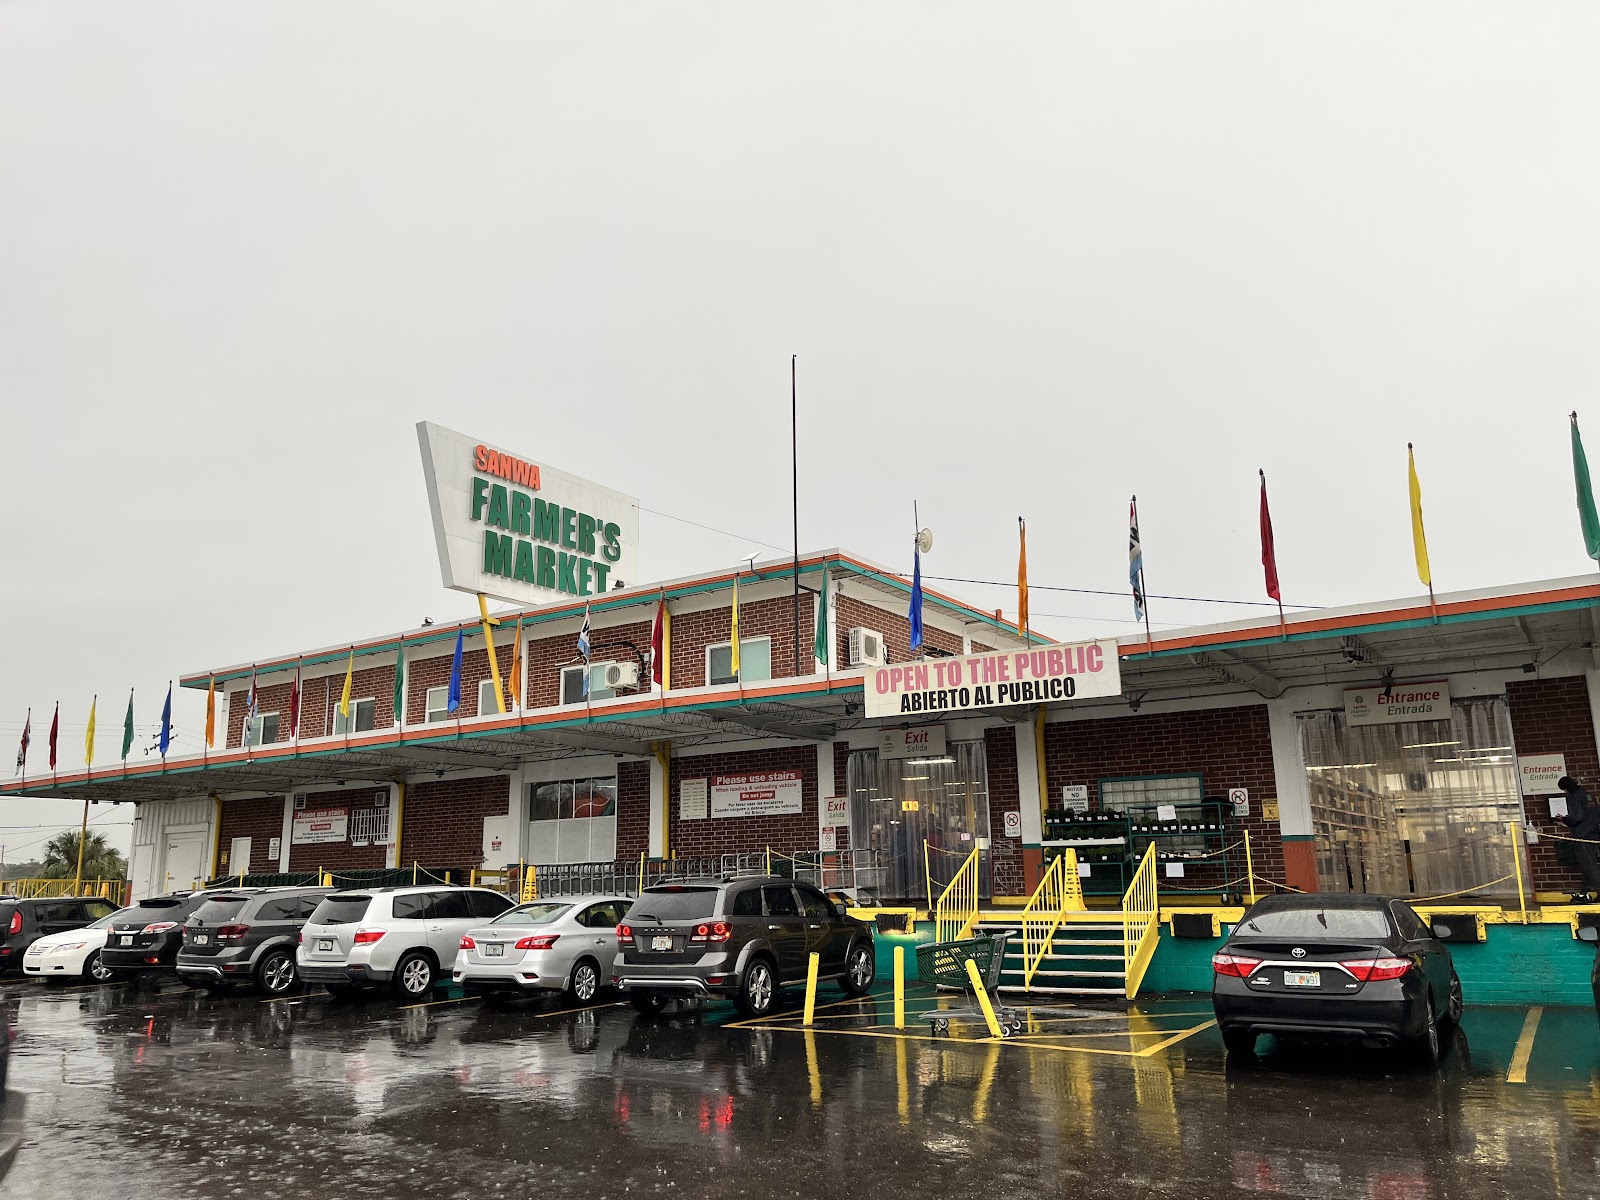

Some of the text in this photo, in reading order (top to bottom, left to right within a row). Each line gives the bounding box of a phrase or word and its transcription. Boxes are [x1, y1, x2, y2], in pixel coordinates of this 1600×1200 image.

[474, 444, 541, 491] SANWA
[469, 476, 621, 563] FARMER'S
[481, 530, 611, 597] MARKET
[875, 644, 1104, 695] OPEN TO THE PUBLIC
[900, 676, 1076, 713] ABIERTO AL PUBLICO
[1377, 690, 1440, 705] Entrance
[1387, 702, 1433, 716] Entrada
[905, 730, 929, 745] Exit
[906, 744, 928, 753] Salida
[1523, 765, 1563, 774] Entrance
[716, 771, 796, 785] Please use stairs
[1530, 773, 1558, 781] Entrada
[759, 791, 773, 799] jump
[827, 800, 846, 812] Exit
[297, 811, 316, 819] Please
[828, 811, 845, 819] Salida
